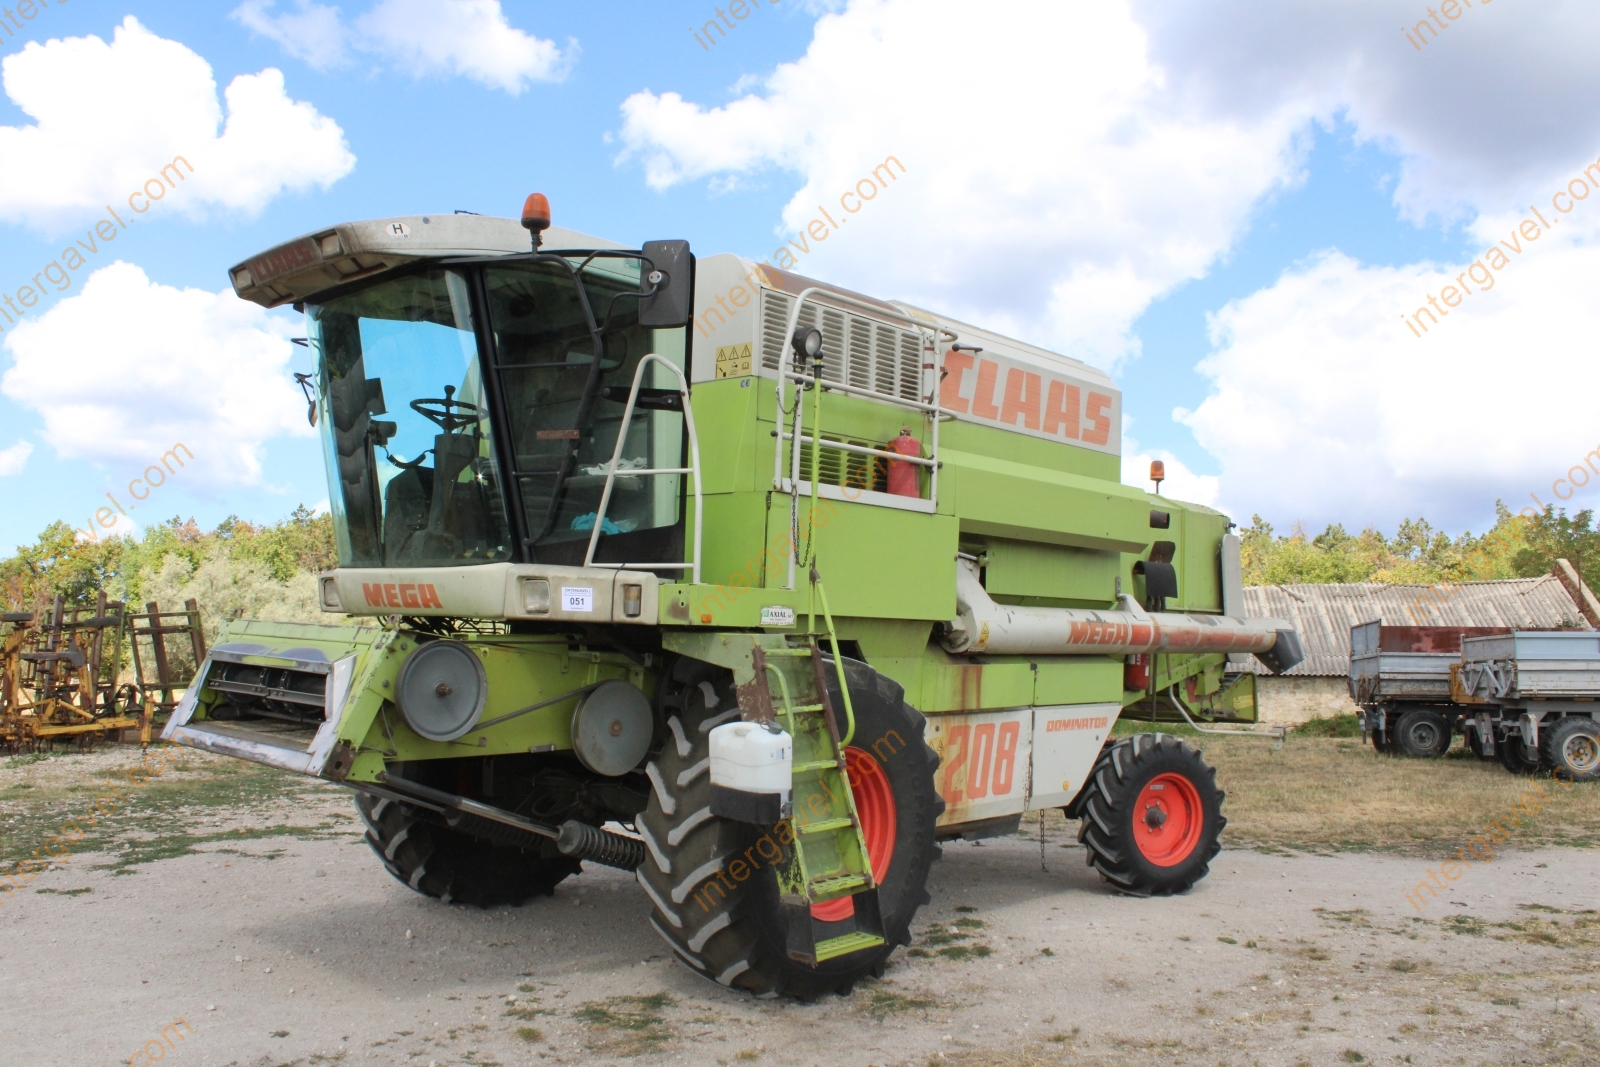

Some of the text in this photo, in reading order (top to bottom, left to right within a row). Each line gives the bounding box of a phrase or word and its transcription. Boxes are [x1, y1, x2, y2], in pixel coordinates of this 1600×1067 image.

[392, 224, 404, 235] H
[251, 242, 312, 282] CLAAS
[939, 350, 1112, 446] CLAAS
[362, 583, 443, 609] MEGA
[570, 597, 585, 605] 051
[1066, 621, 1129, 645] MEGA
[1046, 717, 1108, 732] DOMINATOR
[942, 721, 1020, 804] 208
